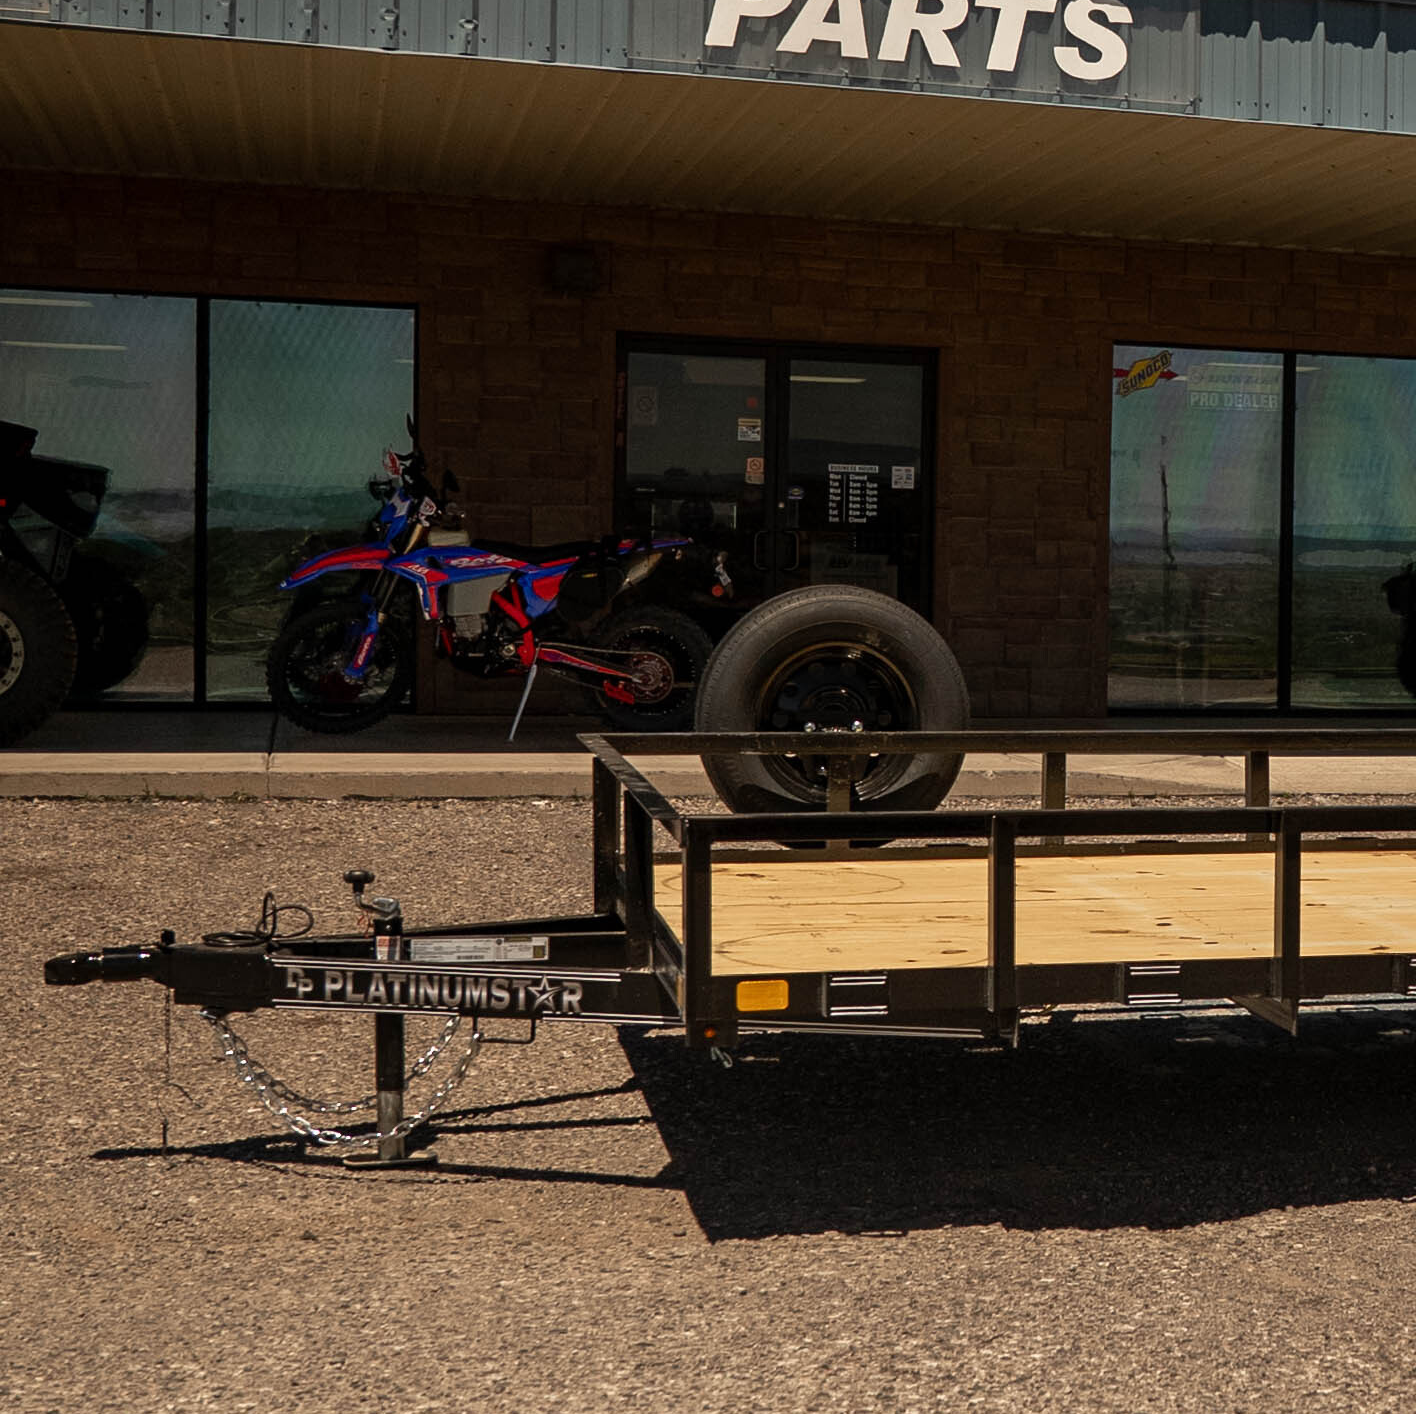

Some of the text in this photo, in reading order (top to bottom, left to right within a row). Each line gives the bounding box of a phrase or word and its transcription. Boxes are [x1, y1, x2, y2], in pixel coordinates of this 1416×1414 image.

[1120, 351, 1171, 396] SUNOCO
[1190, 393, 1279, 411] PRO DEALER
